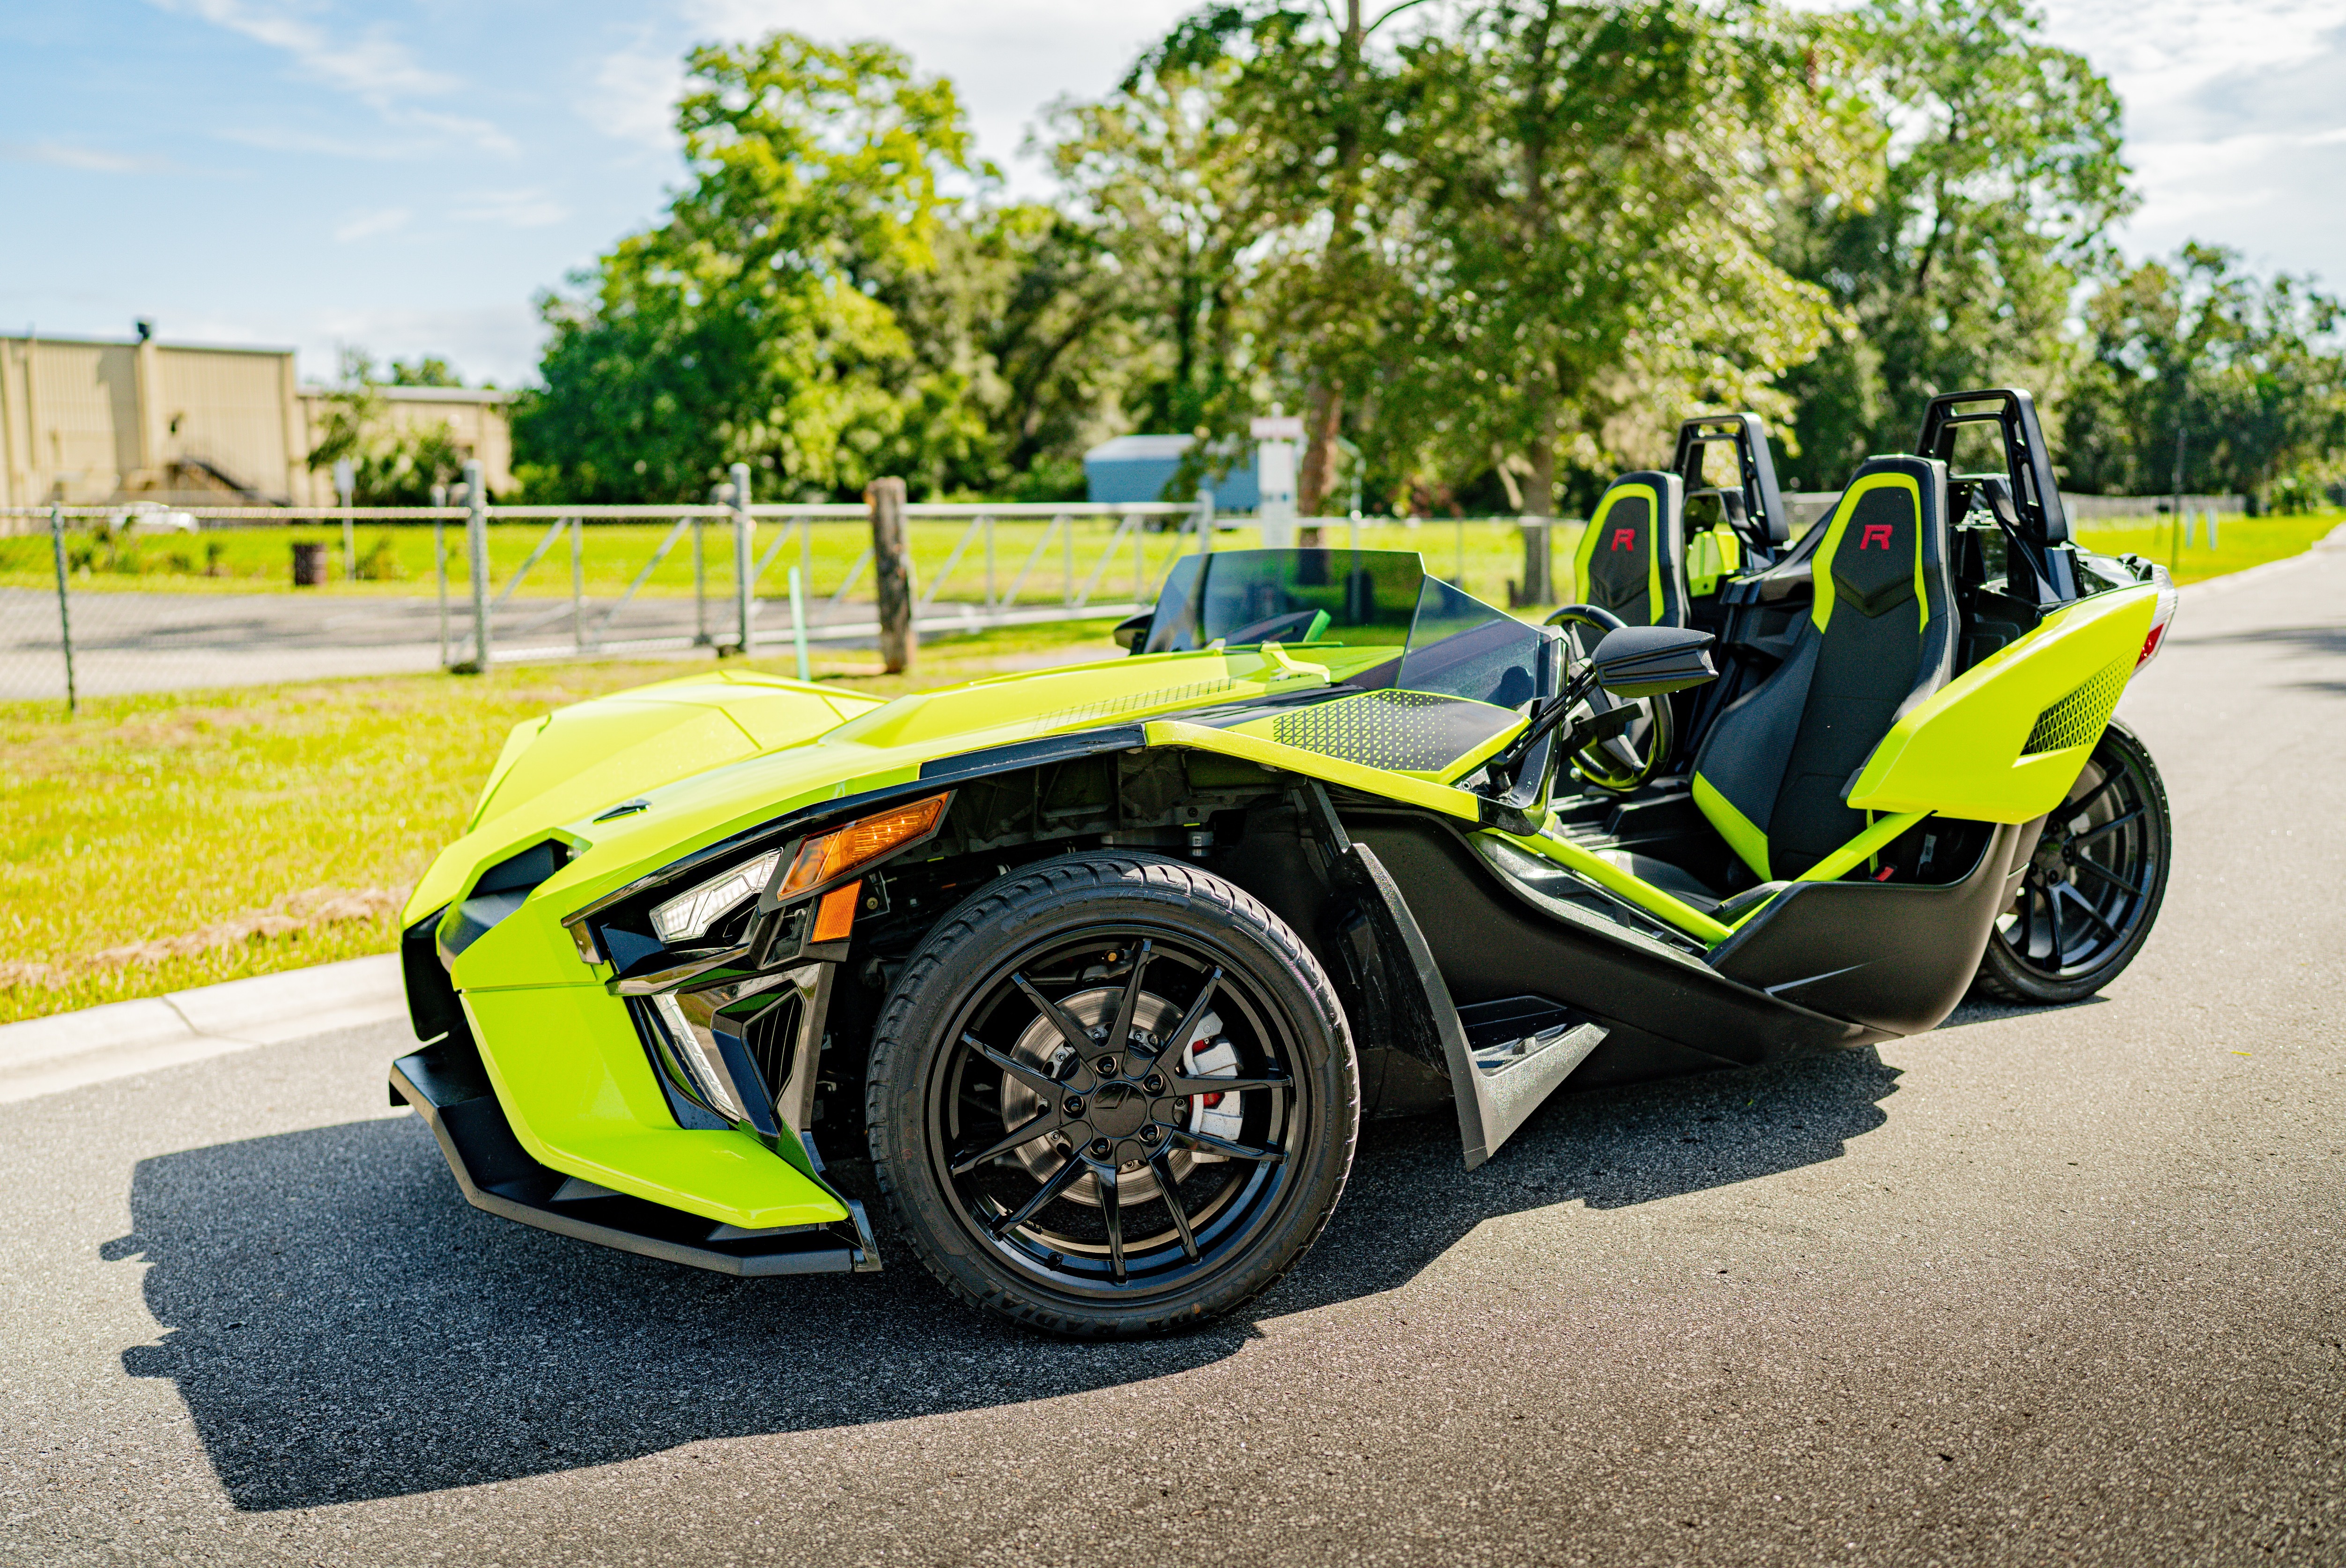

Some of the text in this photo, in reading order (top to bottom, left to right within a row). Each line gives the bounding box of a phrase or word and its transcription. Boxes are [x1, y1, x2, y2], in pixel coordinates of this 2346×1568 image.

[1612, 528, 1635, 552] R
[1859, 525, 1893, 550] R
[1098, 910, 1134, 918] TUBELESS
[913, 979, 954, 1042] ROTATION
[1322, 1103, 1332, 1149] RADIAL
[927, 1217, 943, 1235] DOT
[977, 1268, 1259, 1336] KENDA RADIAL
